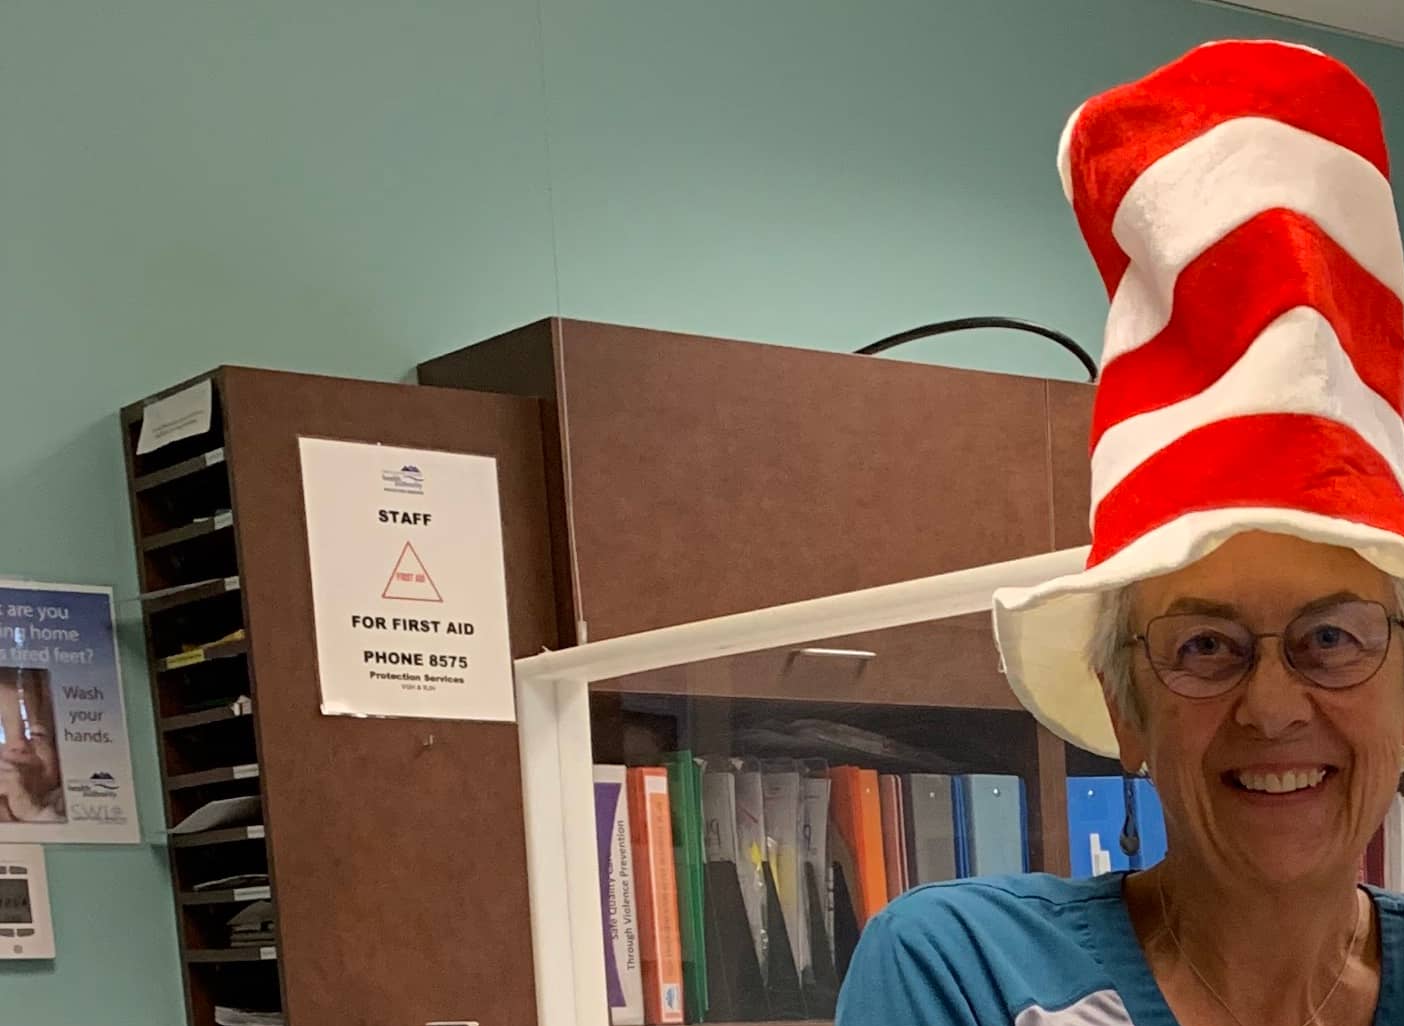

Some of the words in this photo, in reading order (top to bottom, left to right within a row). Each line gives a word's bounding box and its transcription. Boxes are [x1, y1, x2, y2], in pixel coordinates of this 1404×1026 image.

[377, 509, 432, 526] STAFF
[7, 603, 35, 618] are
[37, 604, 70, 622] you
[29, 624, 80, 643] home
[351, 615, 387, 630] FOR
[392, 618, 441, 633] FIRST
[446, 622, 475, 635] AID
[53, 647, 95, 665] feet?
[363, 651, 423, 666] PHONE
[428, 654, 468, 669] 8575
[369, 670, 421, 682] Protection
[424, 673, 465, 684] Services
[62, 685, 104, 700] Wash
[68, 710, 104, 724] your
[64, 729, 113, 744] hands.
[616, 820, 630, 879] Prevention
[622, 880, 633, 922] Violence
[626, 925, 636, 971] Through
